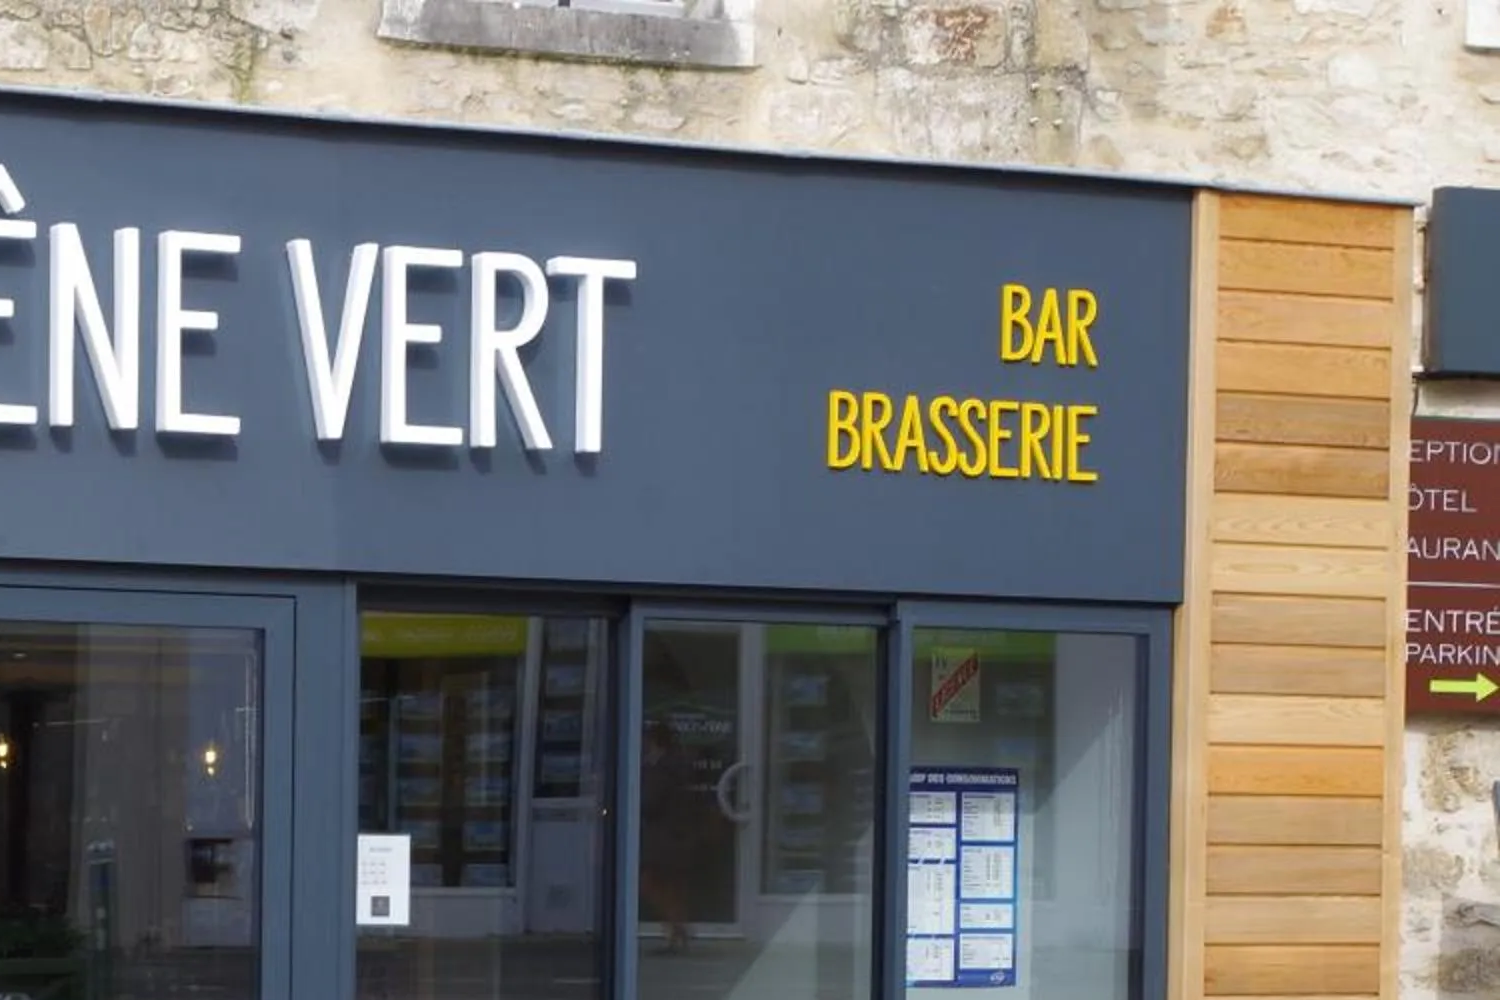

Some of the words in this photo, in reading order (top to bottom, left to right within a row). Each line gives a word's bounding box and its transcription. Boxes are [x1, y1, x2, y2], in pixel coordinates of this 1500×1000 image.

[285, 238, 637, 452] VERT
[1001, 283, 1097, 366] BAR
[827, 390, 1098, 481] BRASSERIE
[1405, 606, 1500, 634] ENTRÉ
[1405, 643, 1500, 665] PARKIN
